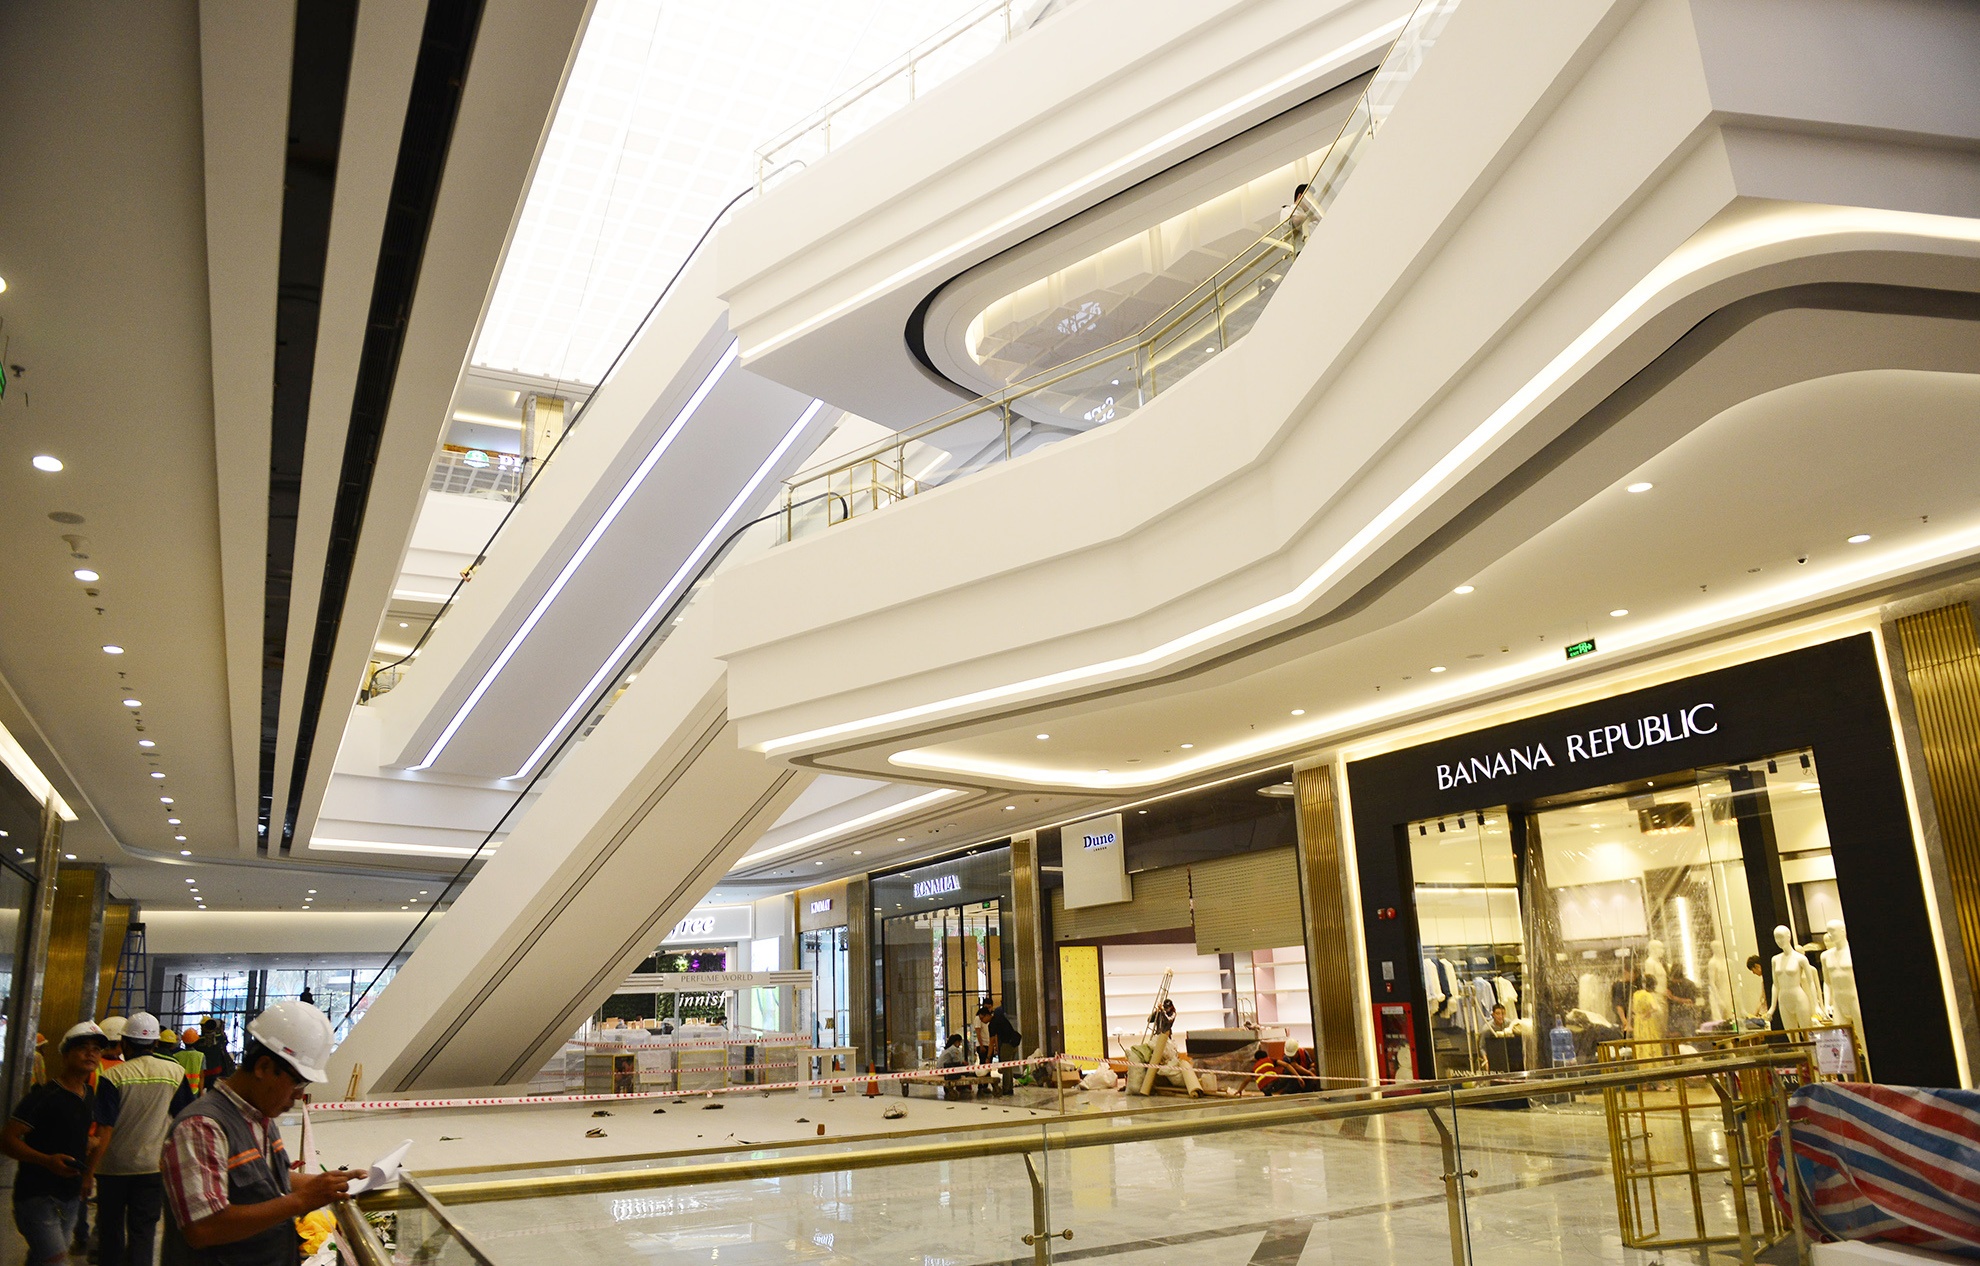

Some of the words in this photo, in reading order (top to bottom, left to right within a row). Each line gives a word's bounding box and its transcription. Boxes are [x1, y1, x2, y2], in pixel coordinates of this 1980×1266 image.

[1436, 743, 1554, 790] BANANA
[1566, 703, 1718, 762] REPUBLIC
[1083, 833, 1114, 848] Dune
[681, 974, 720, 982] PERFUME
[722, 973, 753, 981] WORLD
